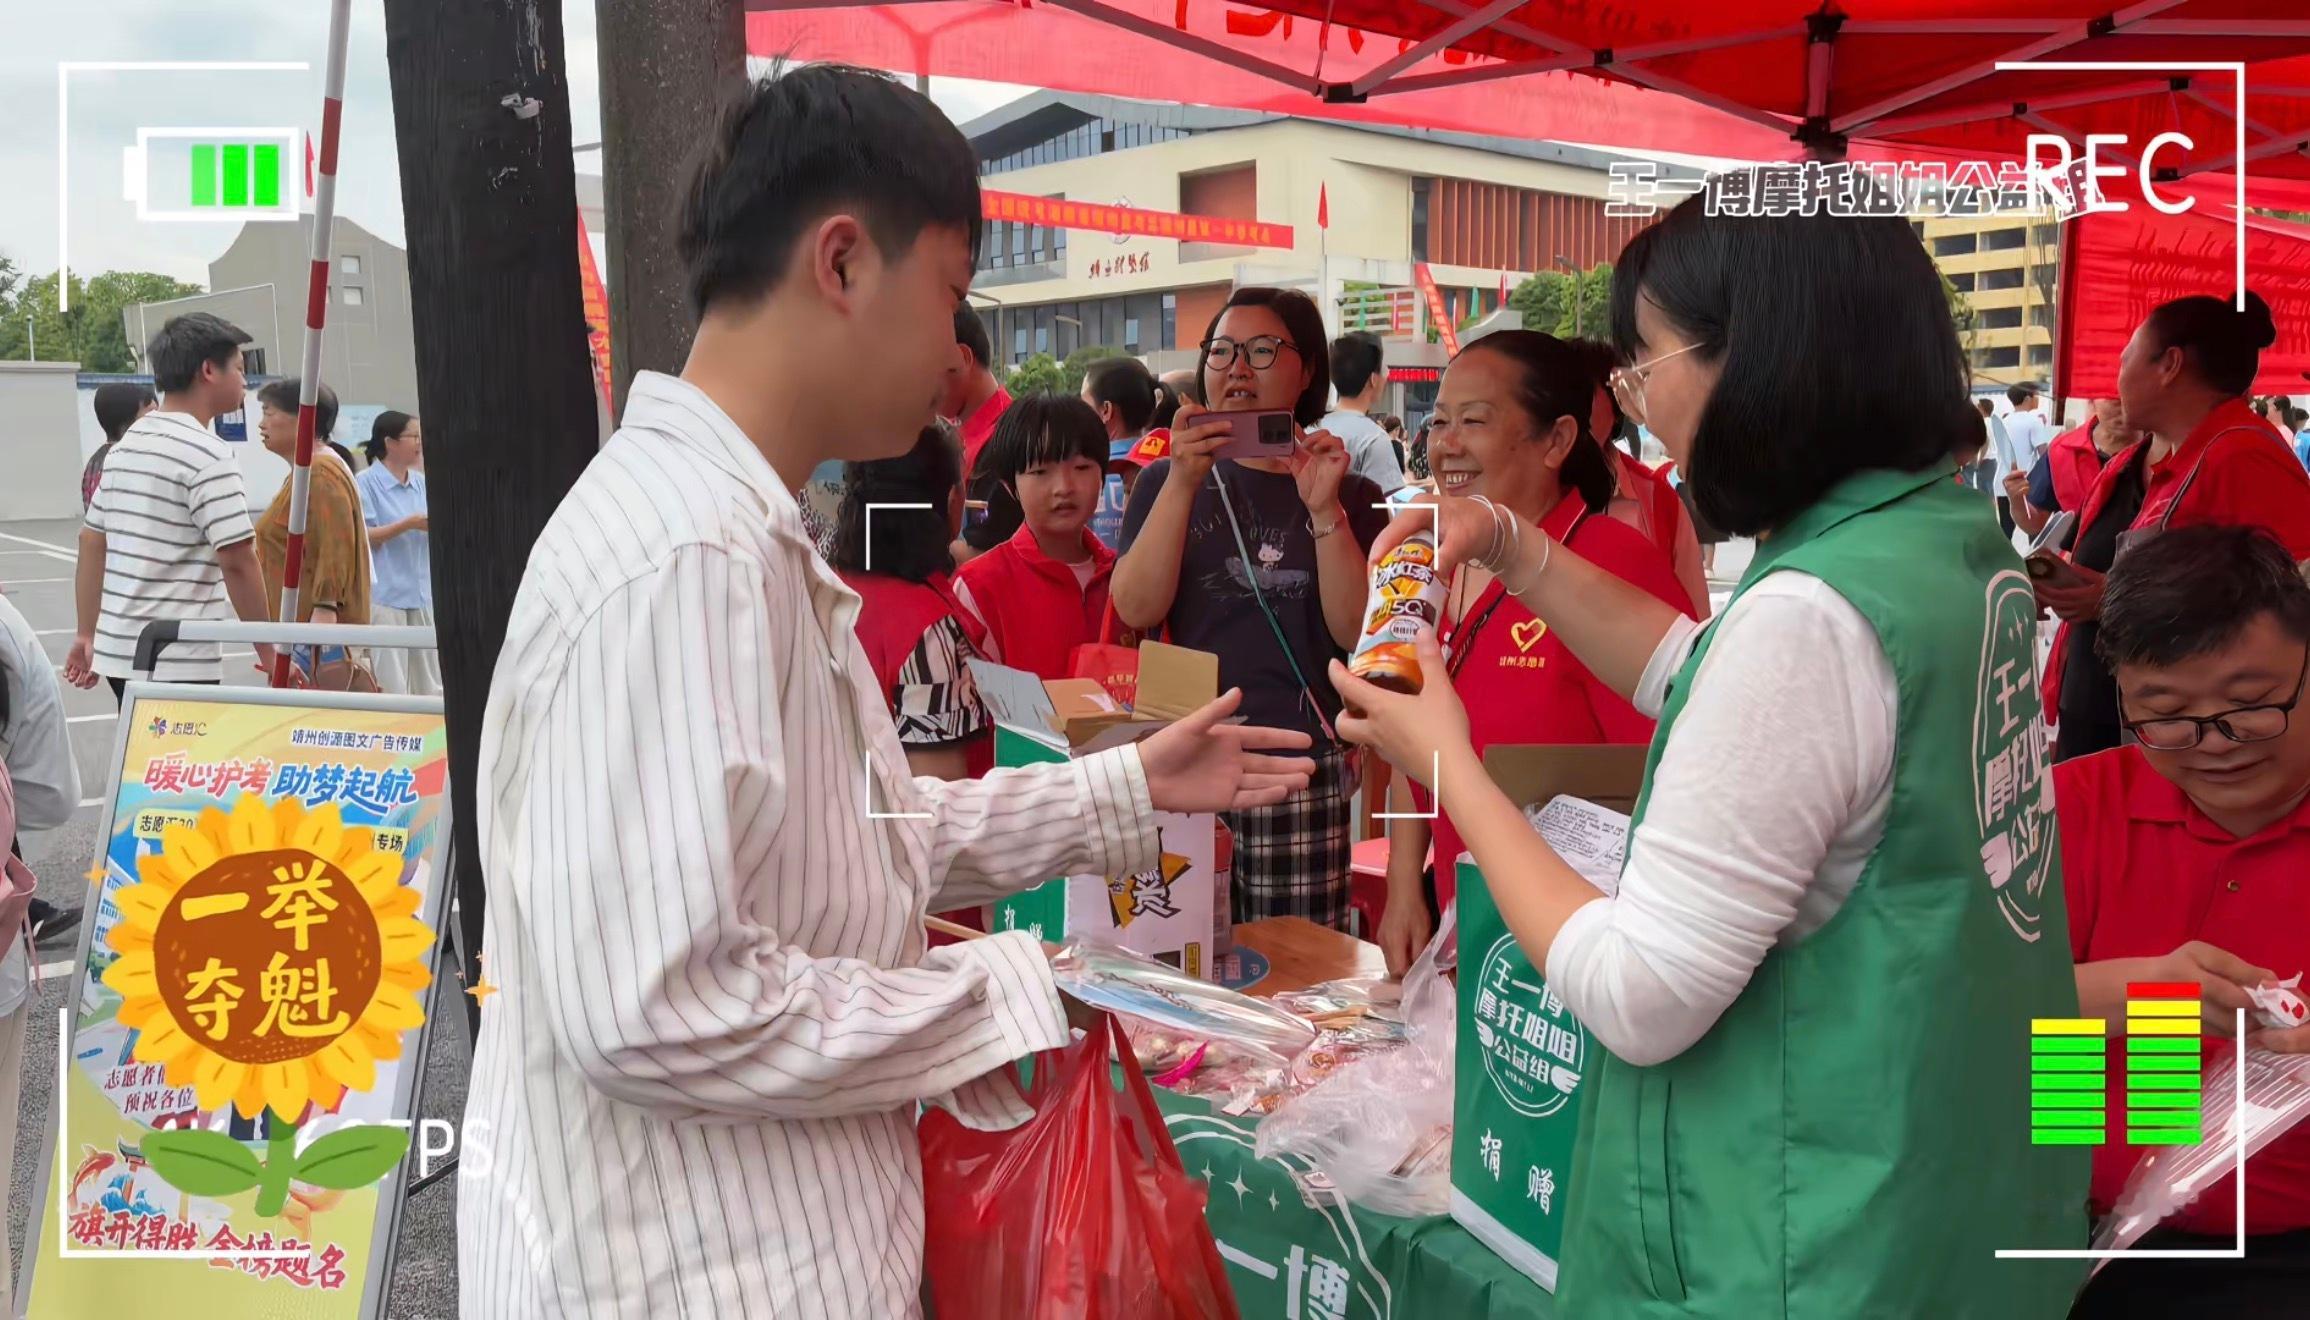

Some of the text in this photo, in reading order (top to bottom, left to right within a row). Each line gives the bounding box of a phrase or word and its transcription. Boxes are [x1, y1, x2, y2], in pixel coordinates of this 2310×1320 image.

[291, 728, 422, 752] 靖州创源图文广告传媒
[144, 752, 417, 814] 暖心护考 助梦起航
[374, 832, 404, 852] 专场
[1477, 986, 1578, 1065] 摩托姐姐
[1493, 1034, 1551, 1086] 公益组
